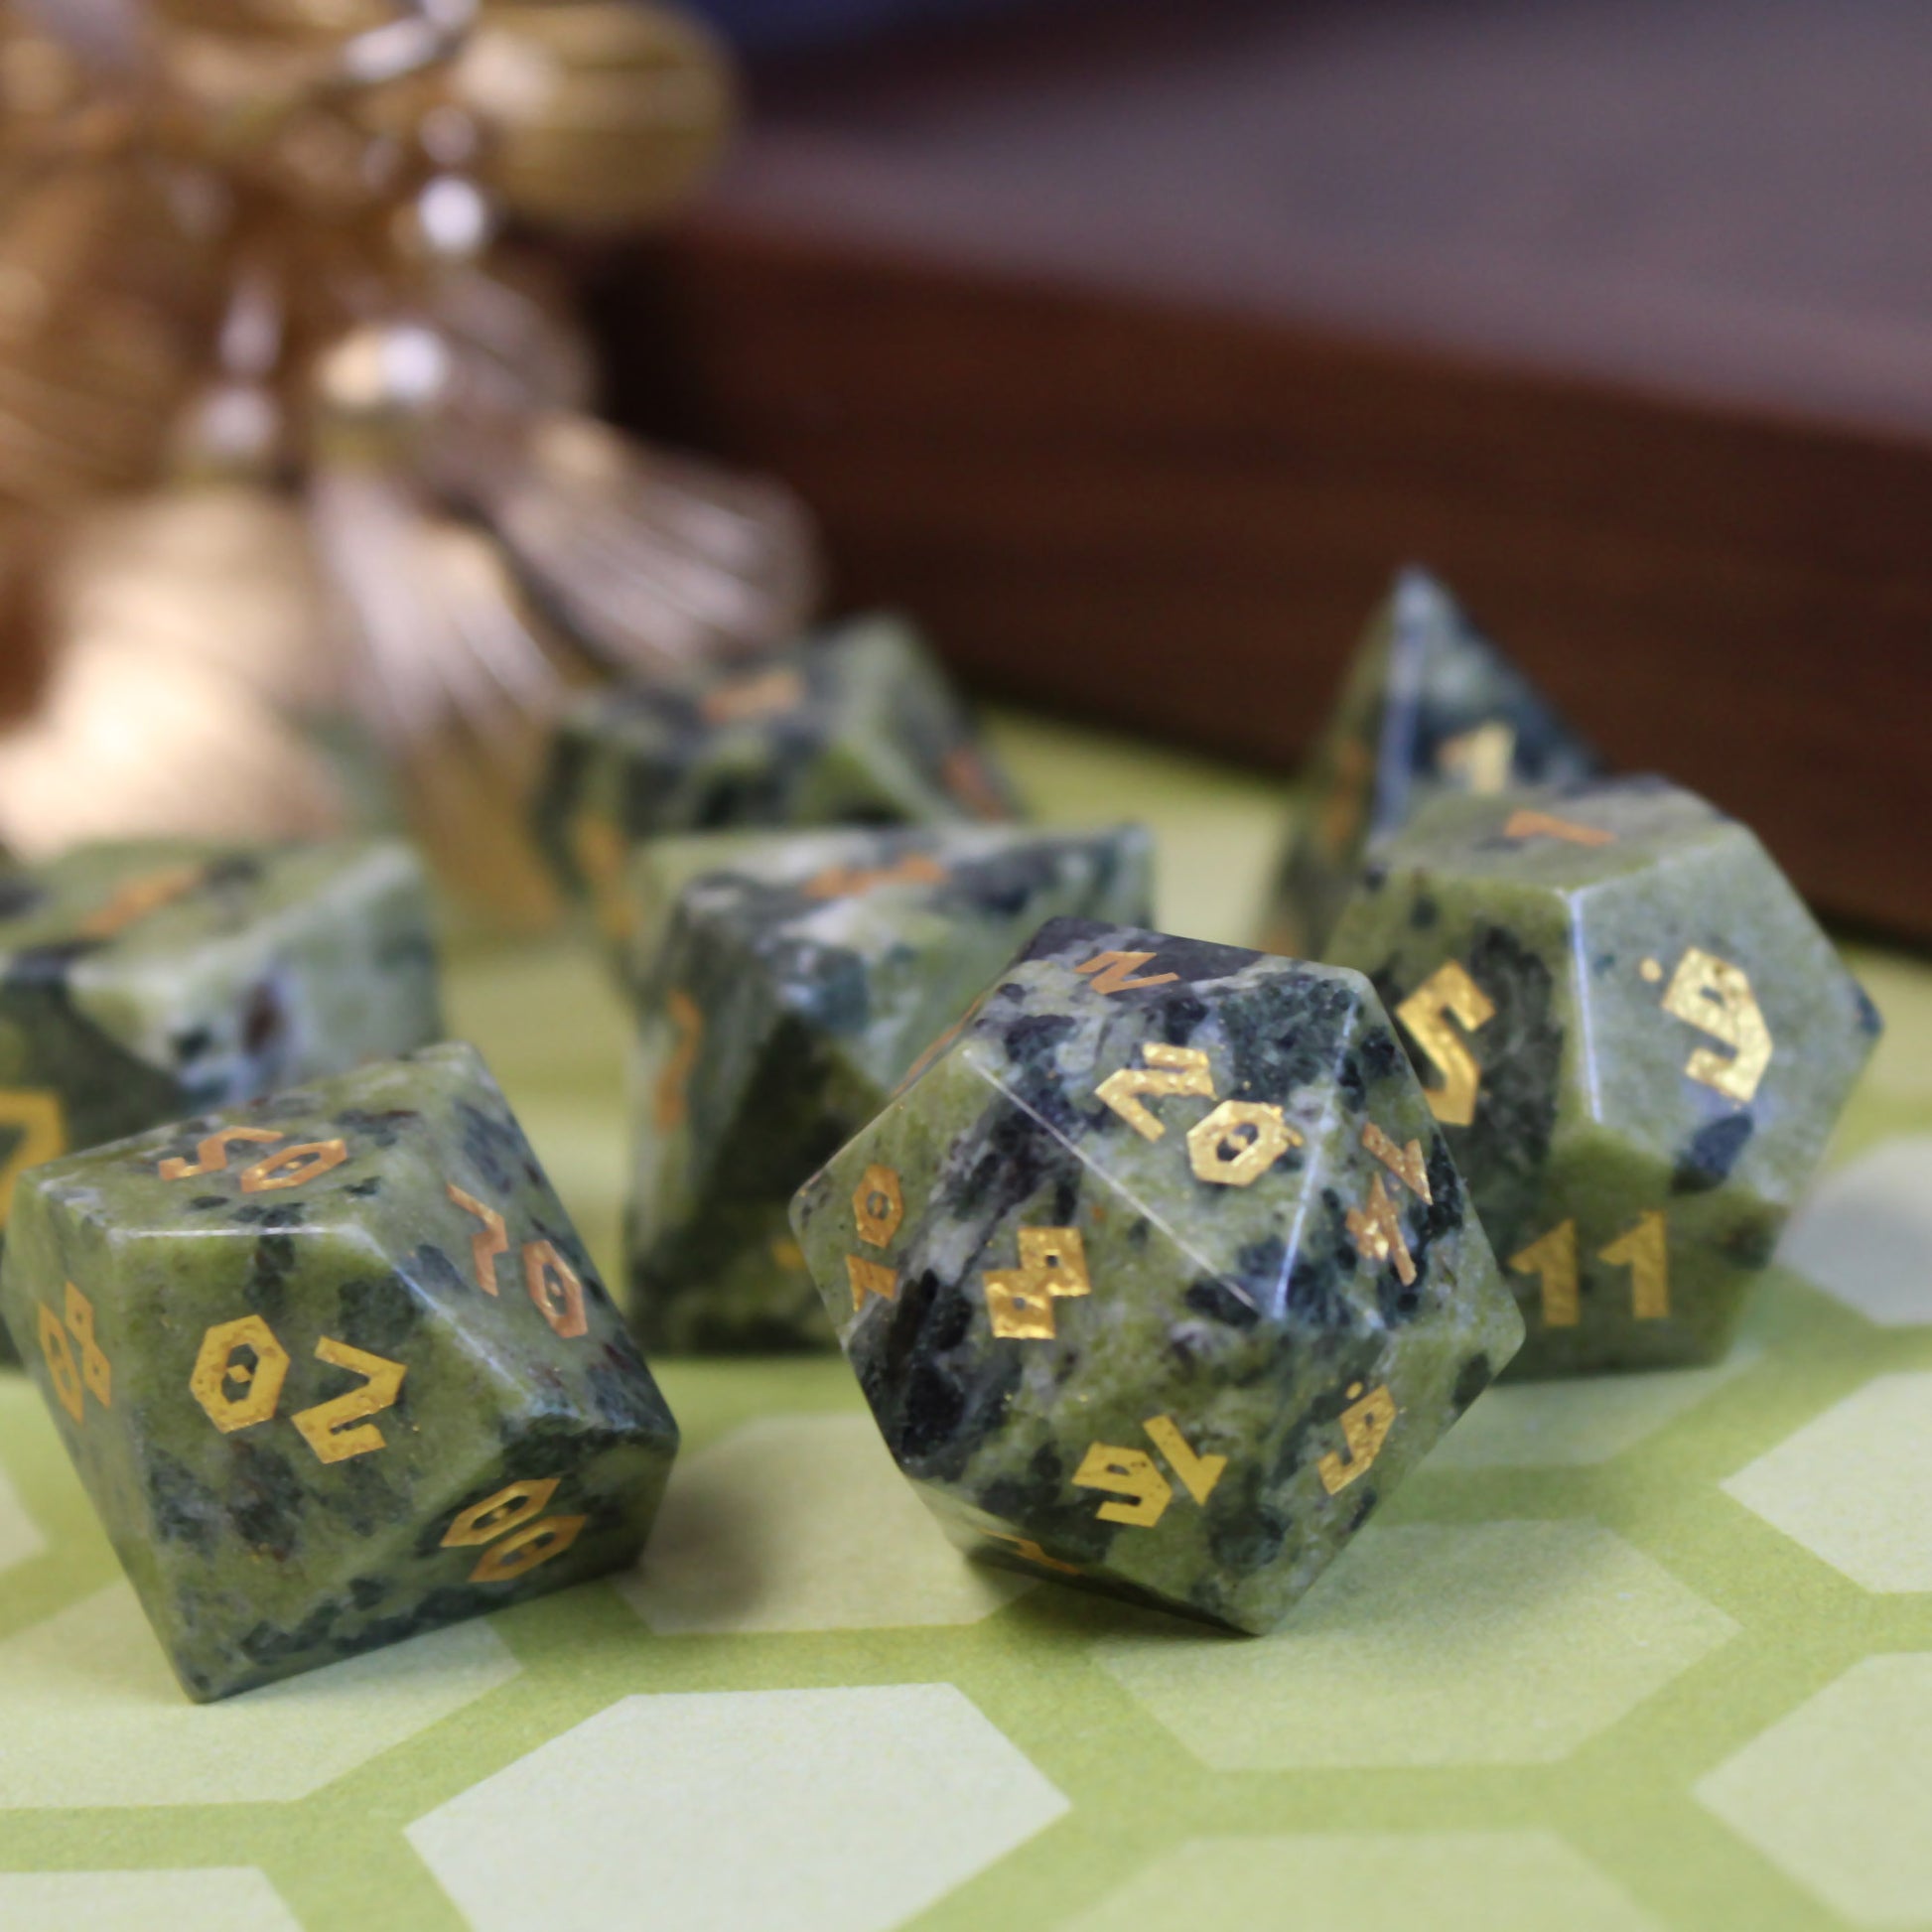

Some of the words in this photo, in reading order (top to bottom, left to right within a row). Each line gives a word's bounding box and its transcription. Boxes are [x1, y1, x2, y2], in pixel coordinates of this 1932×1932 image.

[1094, 1042, 1295, 1187] 20
[981, 1227, 1091, 1340] 8
[1508, 1211, 1671, 1327] 11
[440, 1476, 588, 1584] 00
